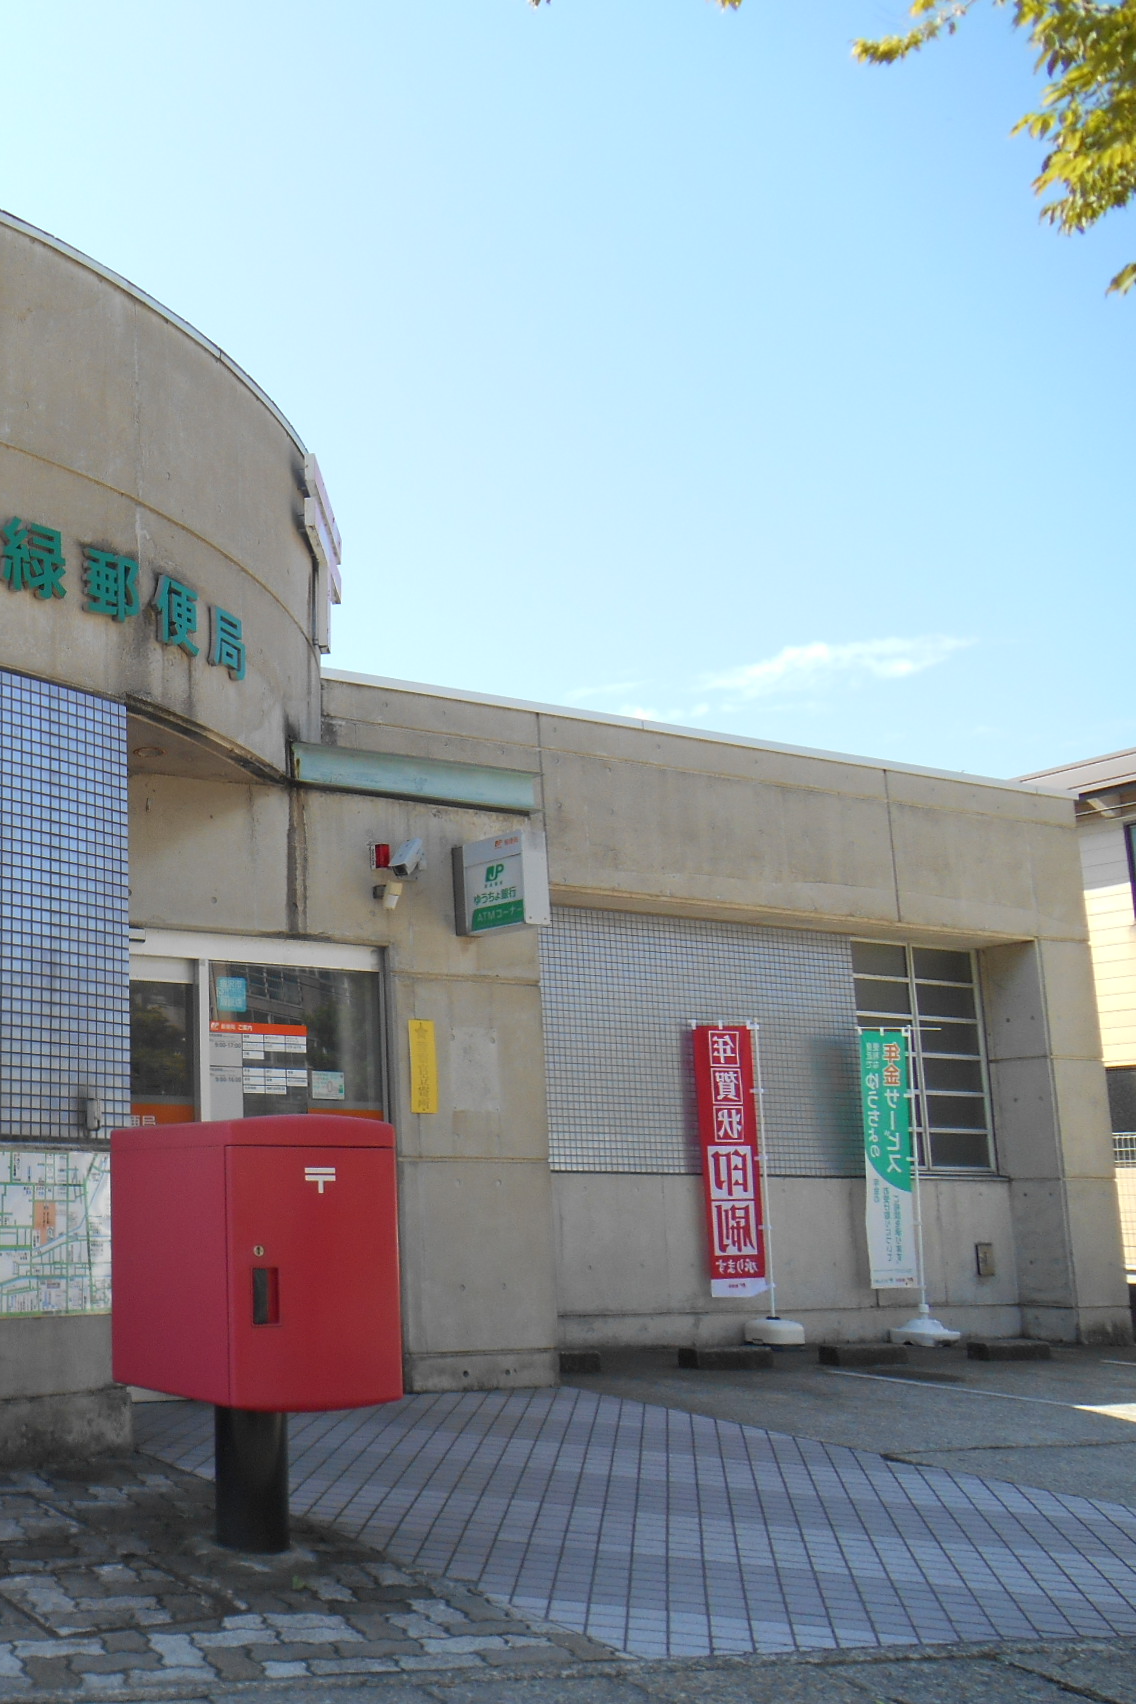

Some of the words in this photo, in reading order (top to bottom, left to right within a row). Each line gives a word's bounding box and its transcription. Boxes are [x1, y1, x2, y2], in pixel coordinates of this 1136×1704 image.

[474, 886, 516, 905] ゆうちょ銀行
[477, 905, 522, 922] ATMコーナー
